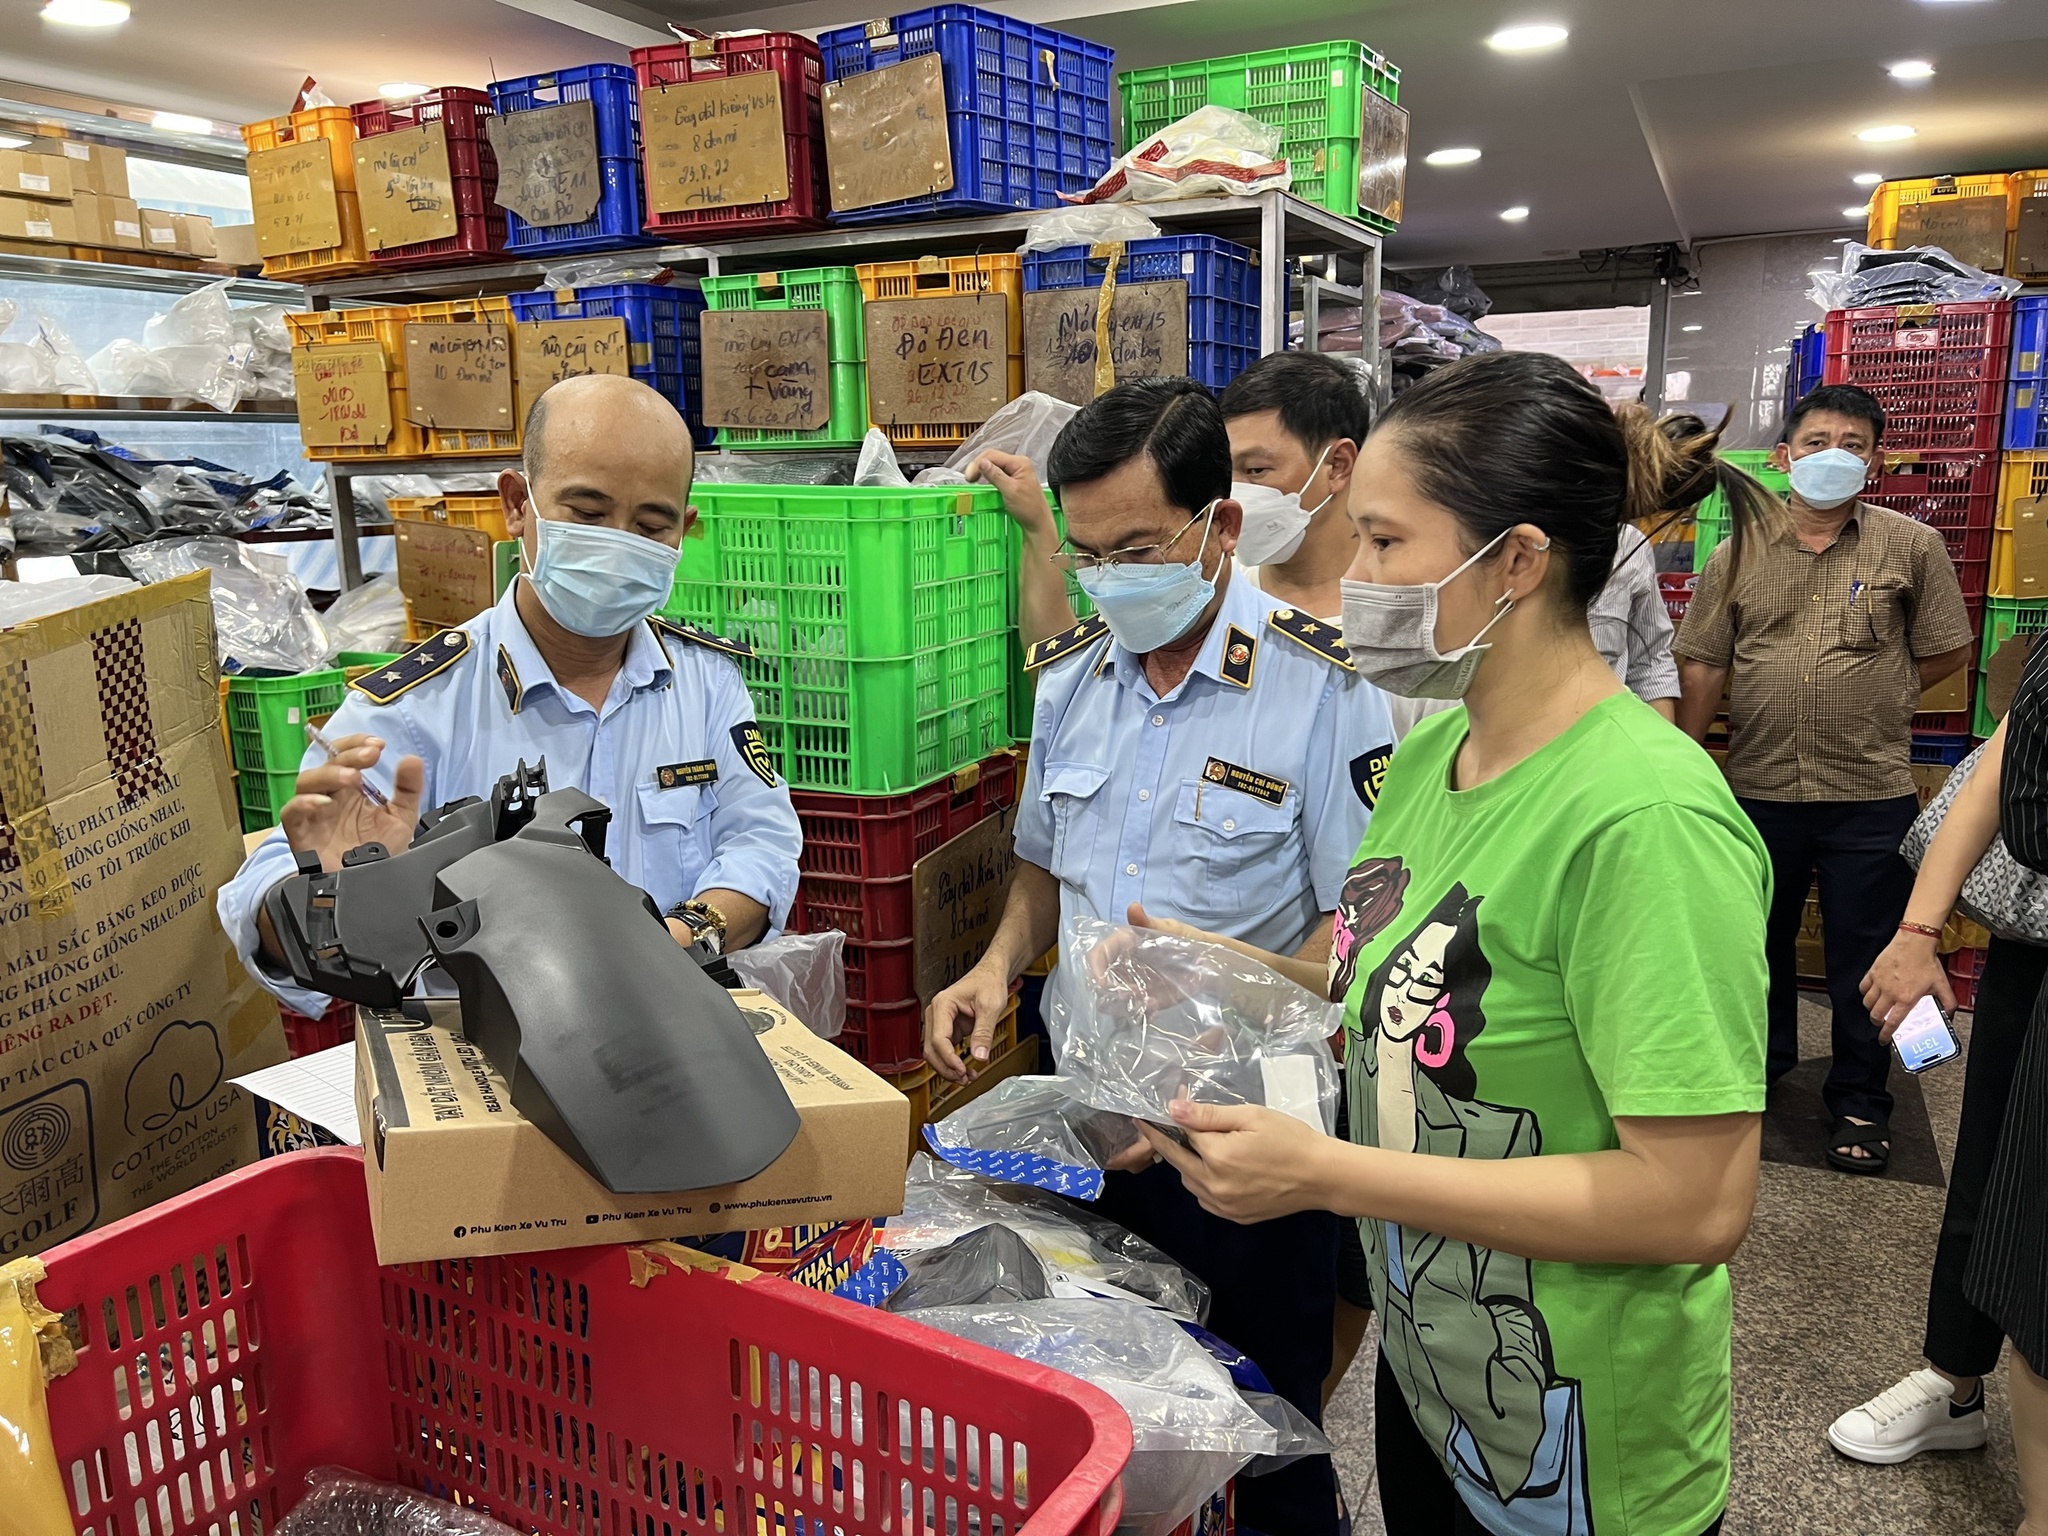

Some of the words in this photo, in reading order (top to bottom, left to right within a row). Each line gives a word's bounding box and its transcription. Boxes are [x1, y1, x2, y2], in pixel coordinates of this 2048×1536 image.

[79, 804, 115, 836] PHÁT
[97, 855, 123, 881] TÔI
[170, 818, 192, 842] KHI
[105, 818, 149, 849] GIỐNG
[6, 945, 49, 976] MÀU
[58, 927, 92, 955] SẮC
[141, 885, 168, 912] KEO
[24, 955, 90, 994] KHÔNG
[93, 928, 139, 964] GIỐNG
[14, 1057, 56, 1084] TÁC
[60, 1039, 99, 1066] CỦA
[101, 1014, 133, 1047] QUÝ
[136, 993, 175, 1026] CÔNG
[175, 979, 192, 1001] TY
[17, 987, 72, 1022] KHÁC
[48, 1012, 75, 1034] RA
[111, 1114, 198, 1181] COTTON
[205, 1087, 242, 1122] USA
[0, 1195, 79, 1255] GOLF
